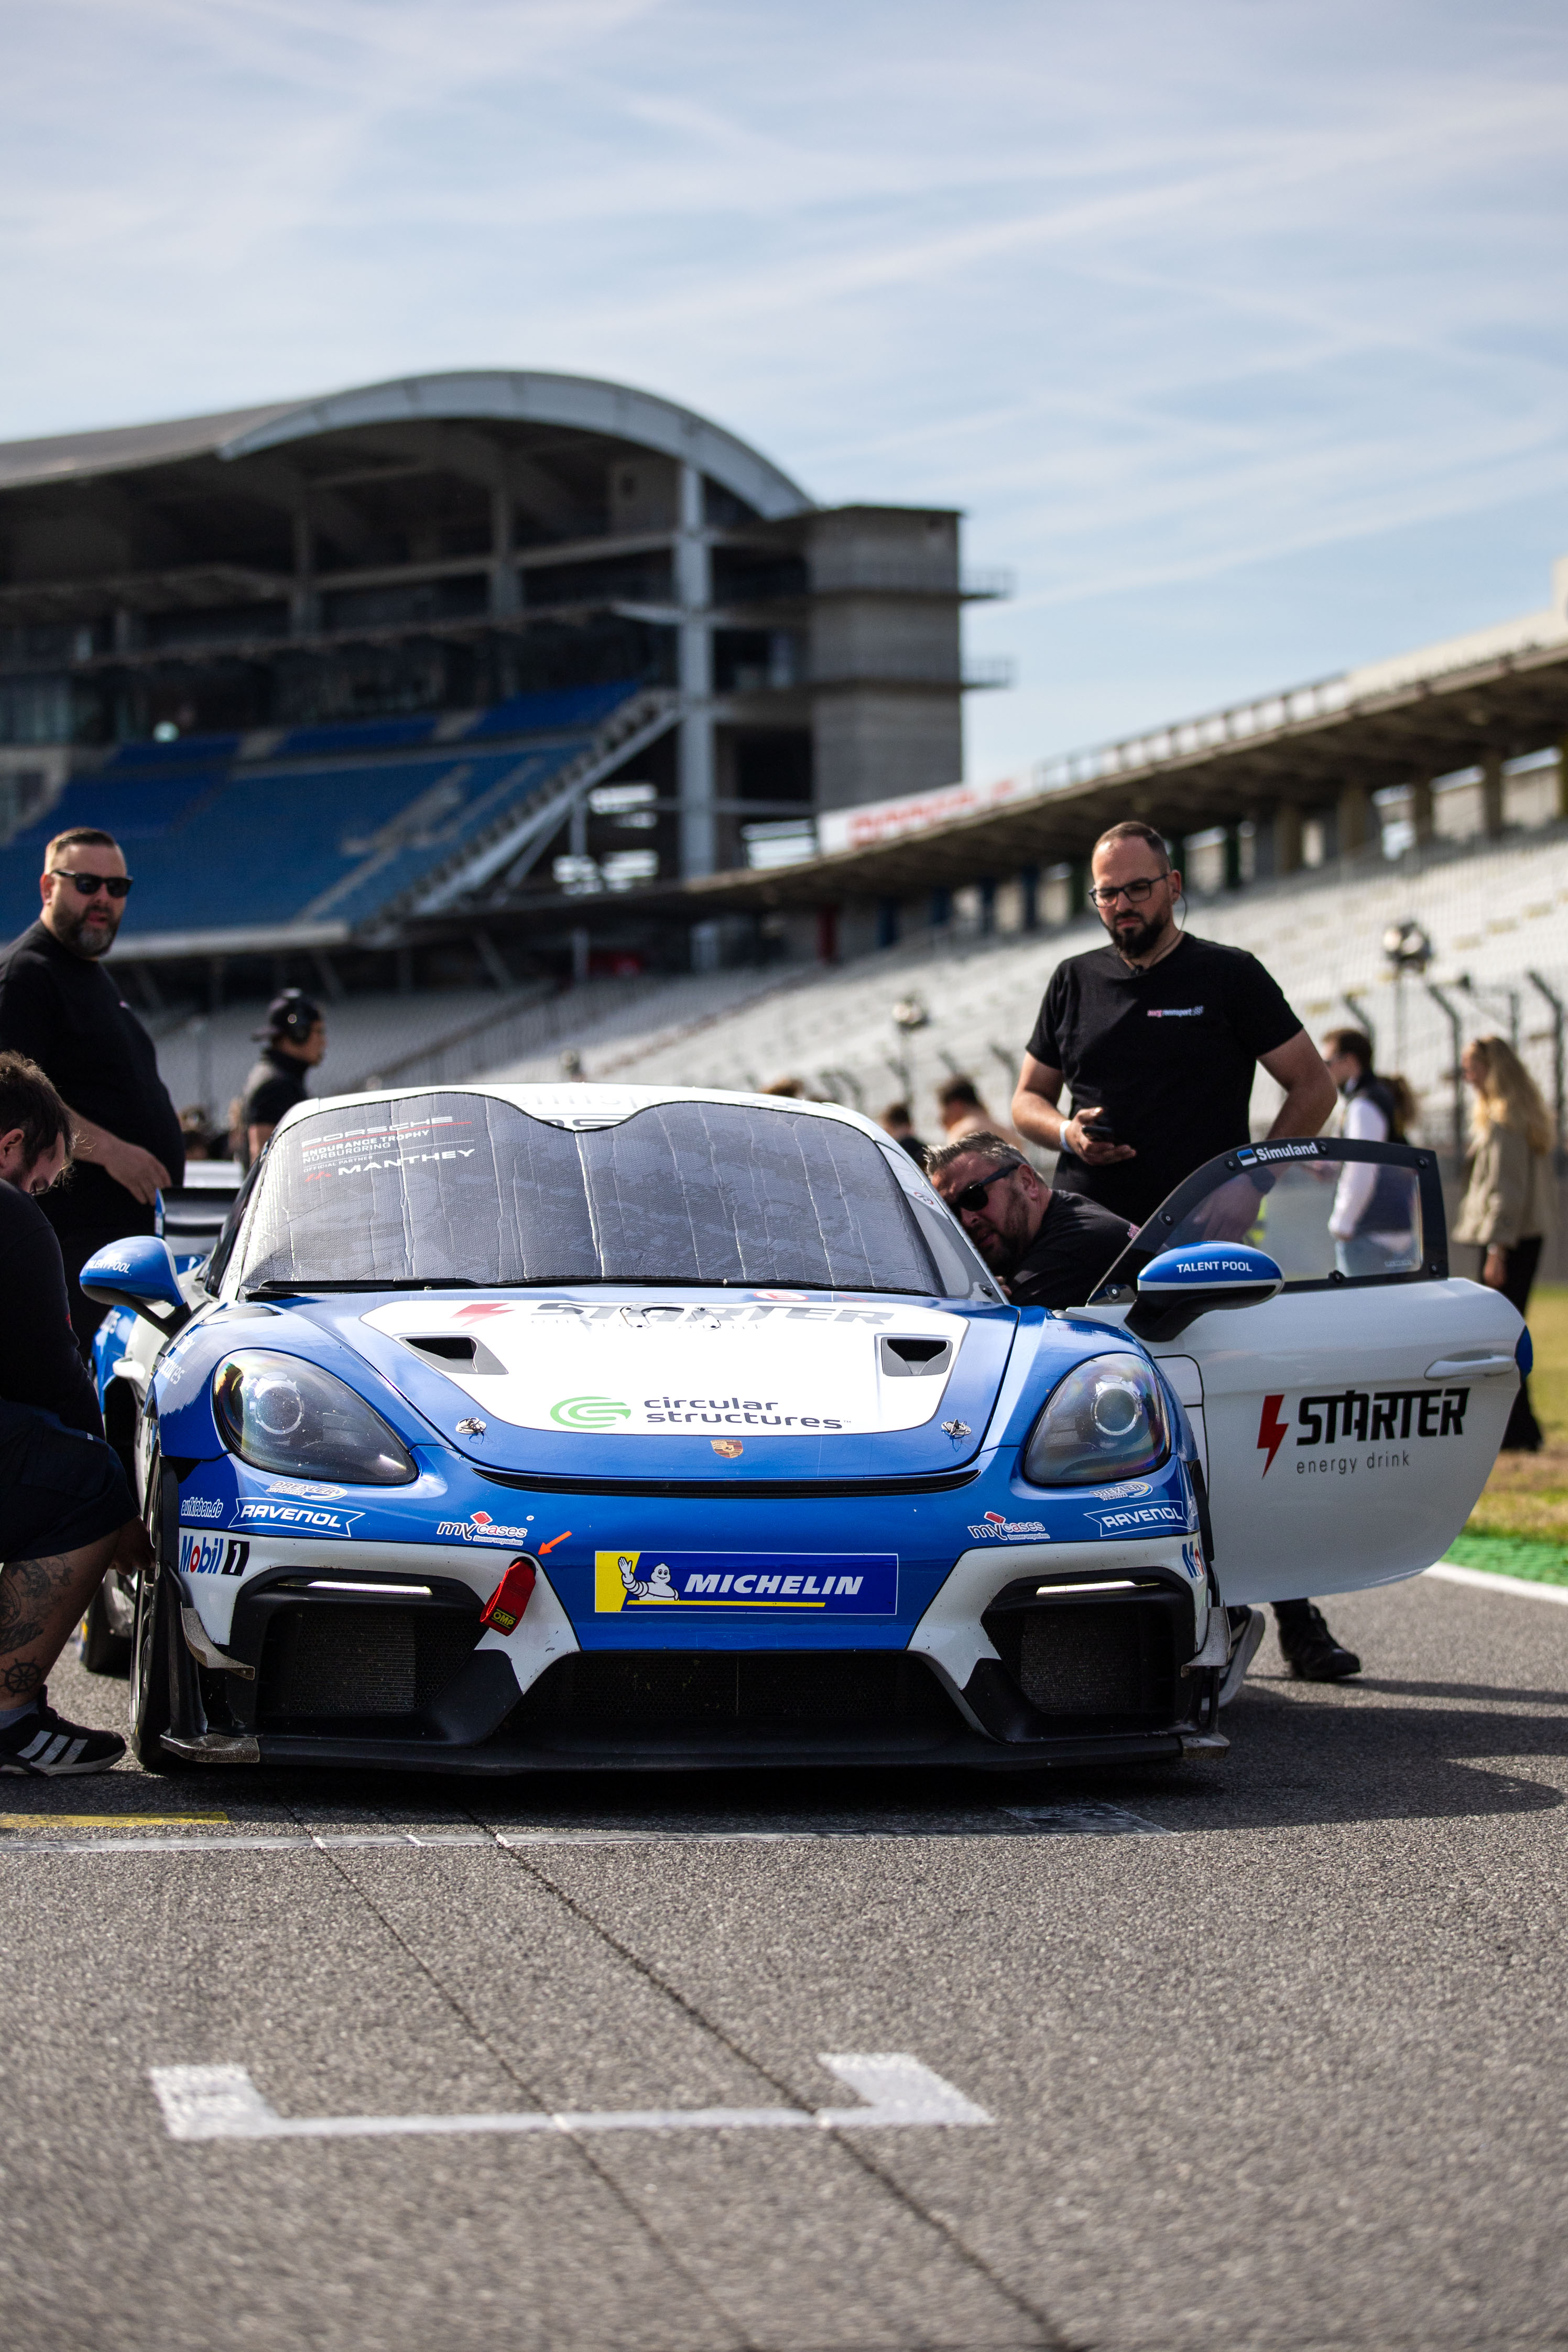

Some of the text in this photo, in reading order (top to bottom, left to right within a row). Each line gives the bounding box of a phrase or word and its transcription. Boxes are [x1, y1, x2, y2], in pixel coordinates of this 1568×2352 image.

[301, 1116, 453, 1148] PORSCHE
[302, 1130, 429, 1158] ENDURANCE TROPHY
[1256, 1142, 1319, 1161] Simuland
[303, 1155, 373, 1172] OFFICIAL PARTNER
[338, 1149, 475, 1175] MANTHEY
[107, 1261, 130, 1273] POOL
[1177, 1261, 1253, 1273] TALENT POOL
[530, 1302, 895, 1326] STARTER
[644, 1397, 778, 1411] circular
[646, 1411, 843, 1429] structures
[1297, 1387, 1470, 1446] STARTER
[1297, 1450, 1409, 1474] energy drink
[271, 1481, 336, 1495] DREXLER
[1090, 1484, 1142, 1497] DREXLER
[181, 1497, 223, 1518] aufkleben.de
[241, 1505, 341, 1528] RAVENOL
[1101, 1507, 1183, 1528] RAVENOL
[180, 1536, 241, 1574] Mobil 1
[684, 1574, 864, 1595] MICHELIN
[493, 1611, 514, 1626] OMP
